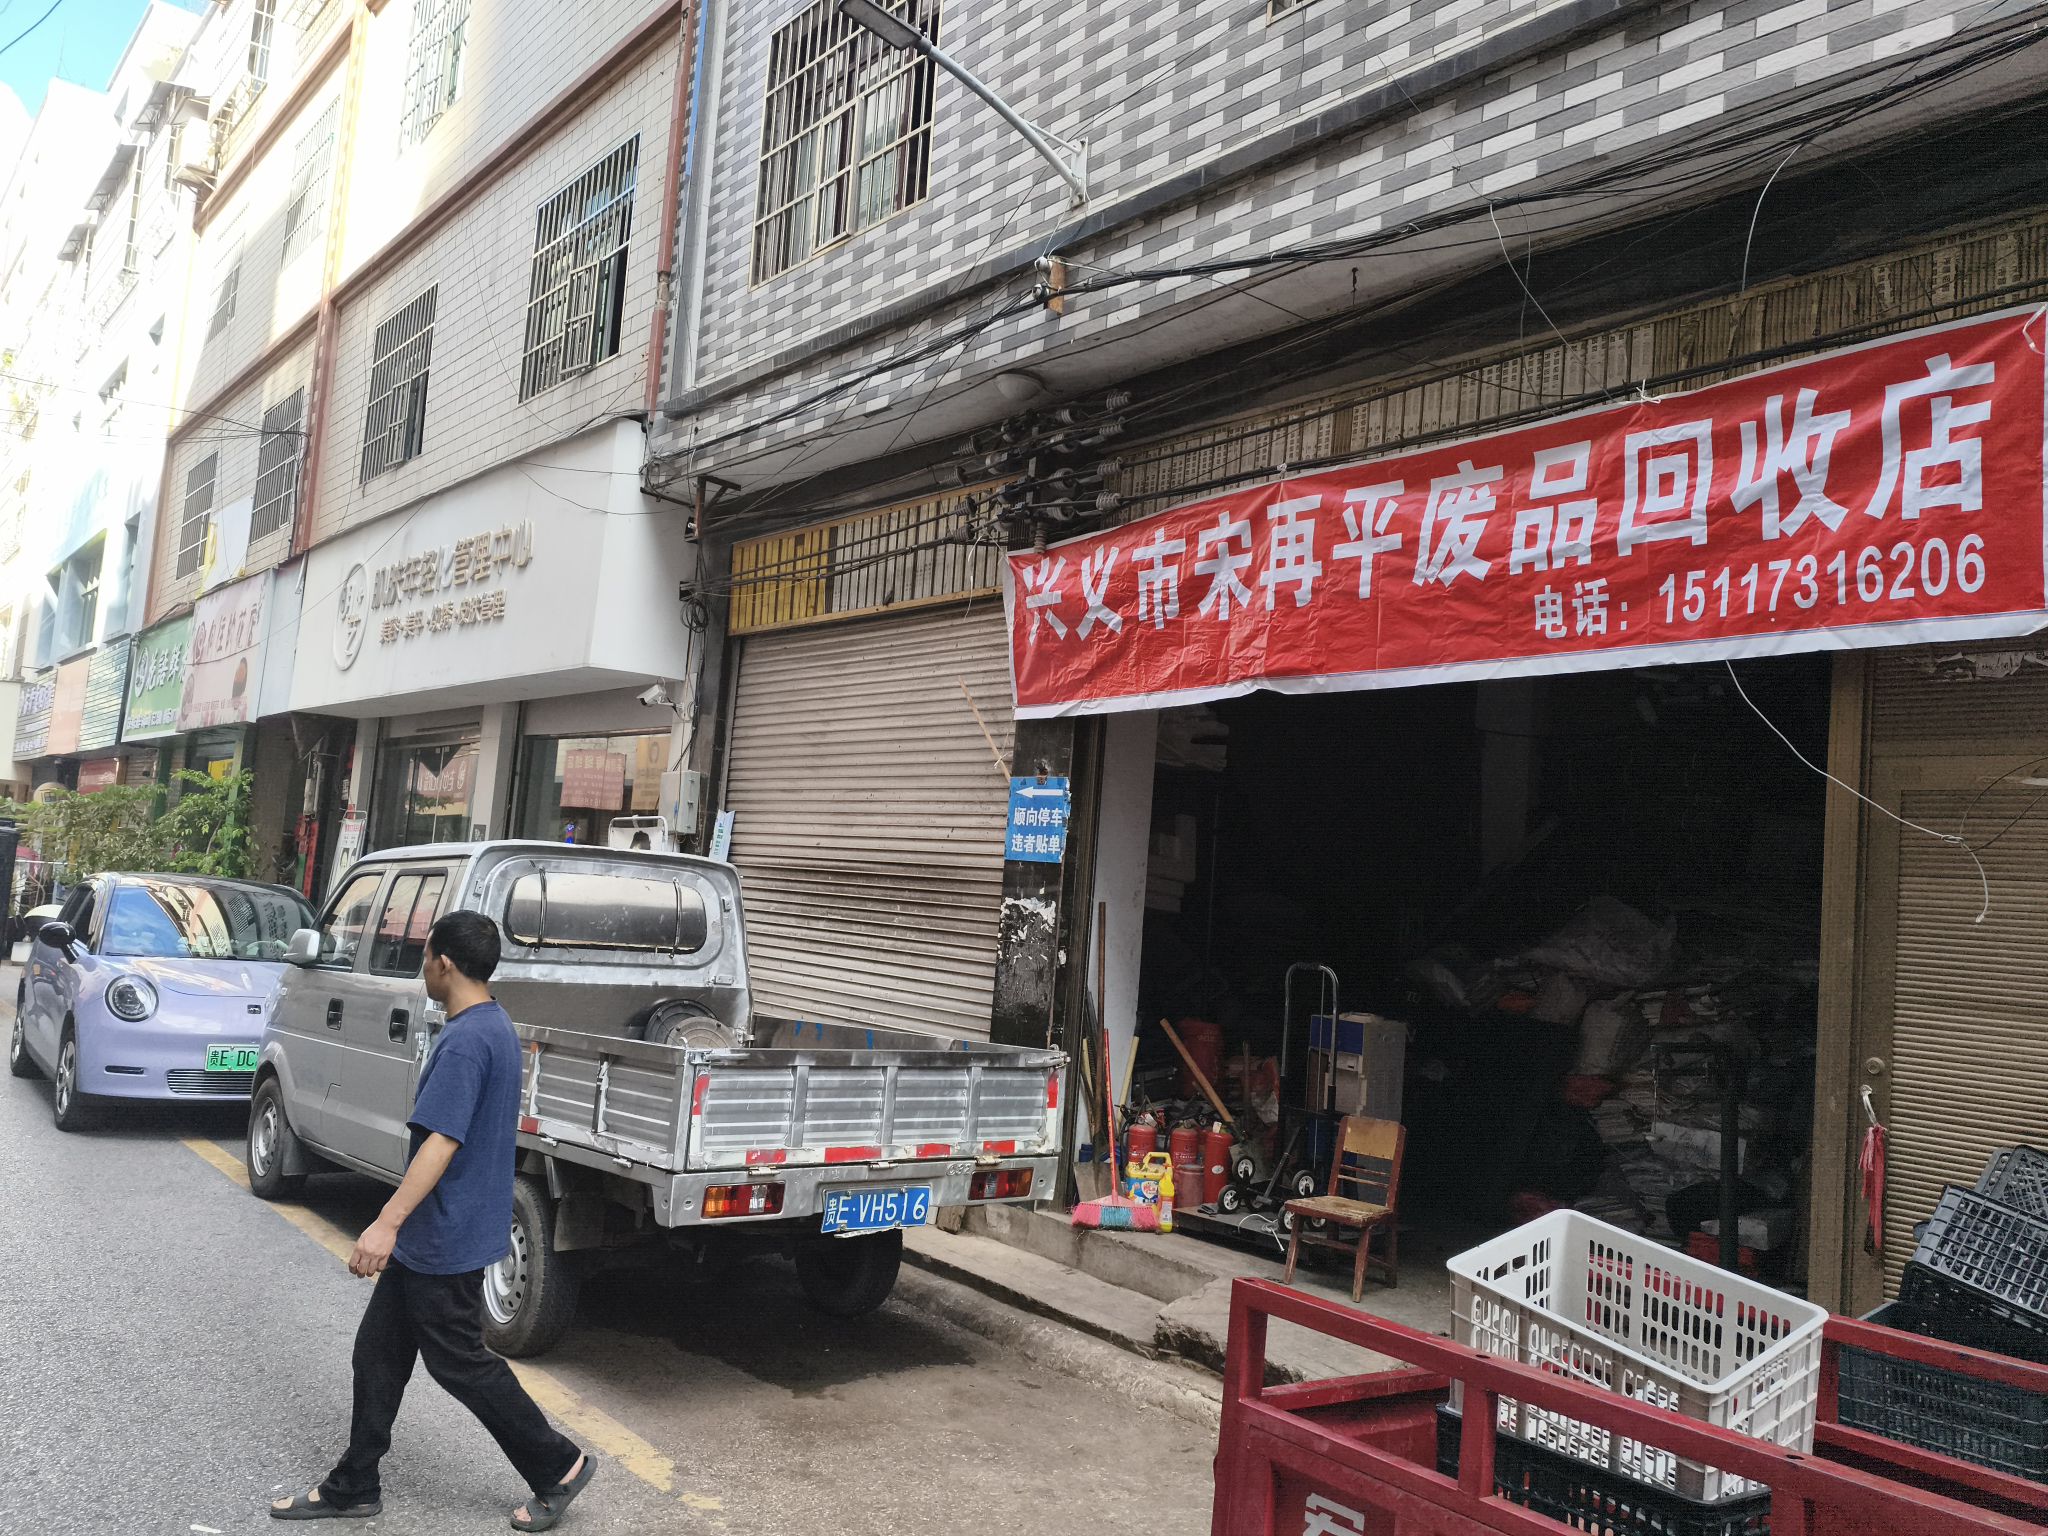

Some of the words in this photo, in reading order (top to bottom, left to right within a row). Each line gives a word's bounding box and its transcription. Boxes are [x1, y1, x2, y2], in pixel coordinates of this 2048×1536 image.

[1021, 352, 1996, 646] 兴义市宋再平废品回收店
[371, 517, 534, 610] 肌肤年轻化管理中心
[1658, 533, 1987, 624] 15117316206
[1011, 833, 1061, 855] 违者贴单
[1013, 807, 1063, 828] 顺向停车
